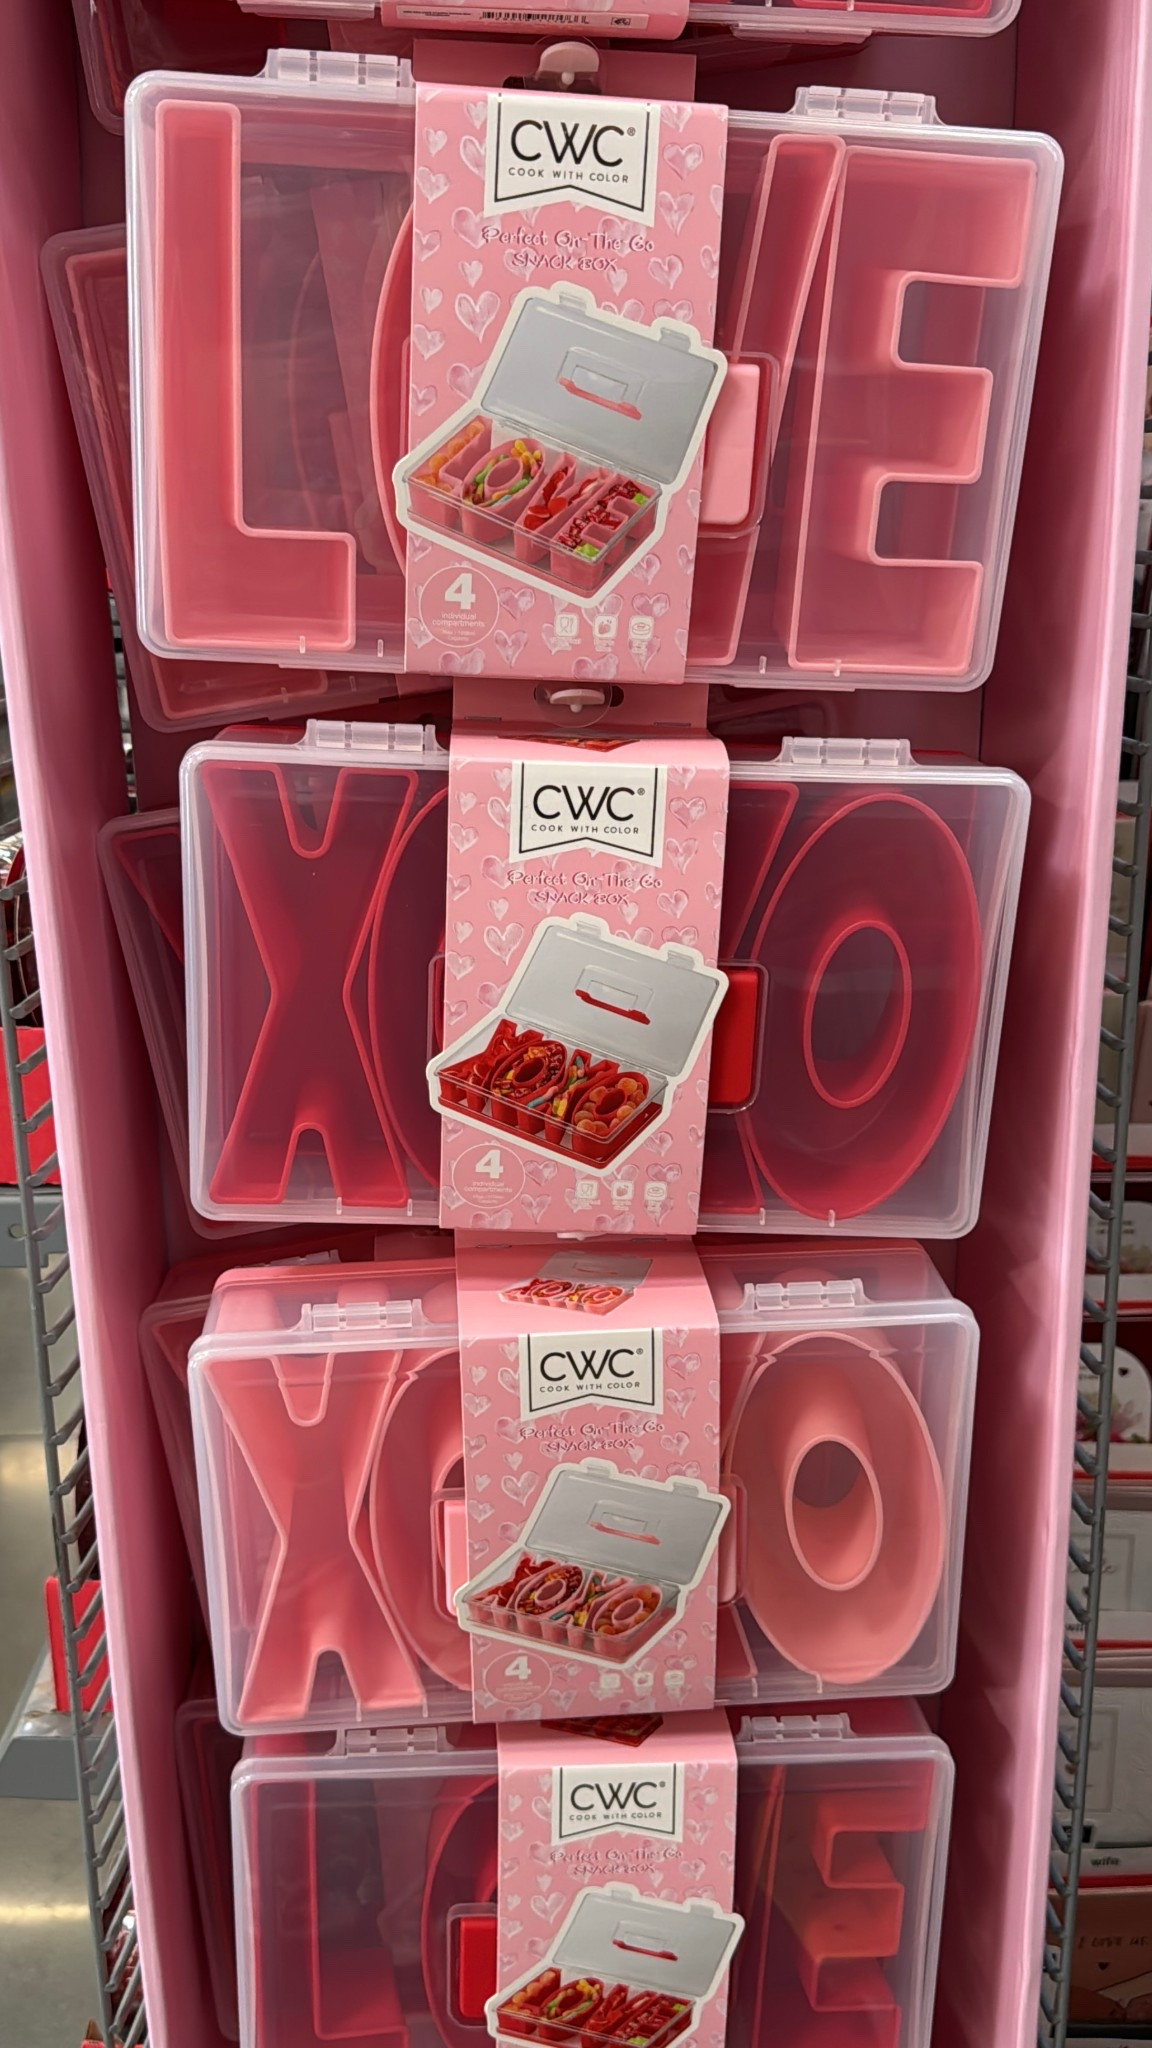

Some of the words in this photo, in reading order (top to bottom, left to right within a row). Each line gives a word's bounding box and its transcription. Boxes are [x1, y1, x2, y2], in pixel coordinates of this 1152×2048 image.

[508, 167, 544, 178] COOK
[552, 170, 584, 181] WITH
[589, 172, 630, 184] COLOR
[481, 225, 549, 246] Perfect
[511, 252, 573, 270] SNACK
[577, 256, 618, 271] BOX
[444, 572, 476, 610] 4
[432, 619, 485, 628] compartments
[441, 612, 477, 620] individual
[531, 824, 564, 832] COOK
[570, 825, 599, 833] WITH
[603, 826, 639, 834] COLOR
[507, 869, 568, 886] Perfect
[534, 891, 589, 905] SNACK
[593, 893, 630, 906] BOX
[475, 1149, 504, 1179] 4
[539, 1385, 569, 1393] COOK
[576, 1383, 602, 1391] WITH
[607, 1381, 640, 1390] COLOR
[519, 1425, 576, 1440] Perfect
[545, 1440, 598, 1452] SNACK
[504, 1655, 532, 1681] 4
[569, 1814, 597, 1822] COOK
[631, 1811, 662, 1820] COLOR
